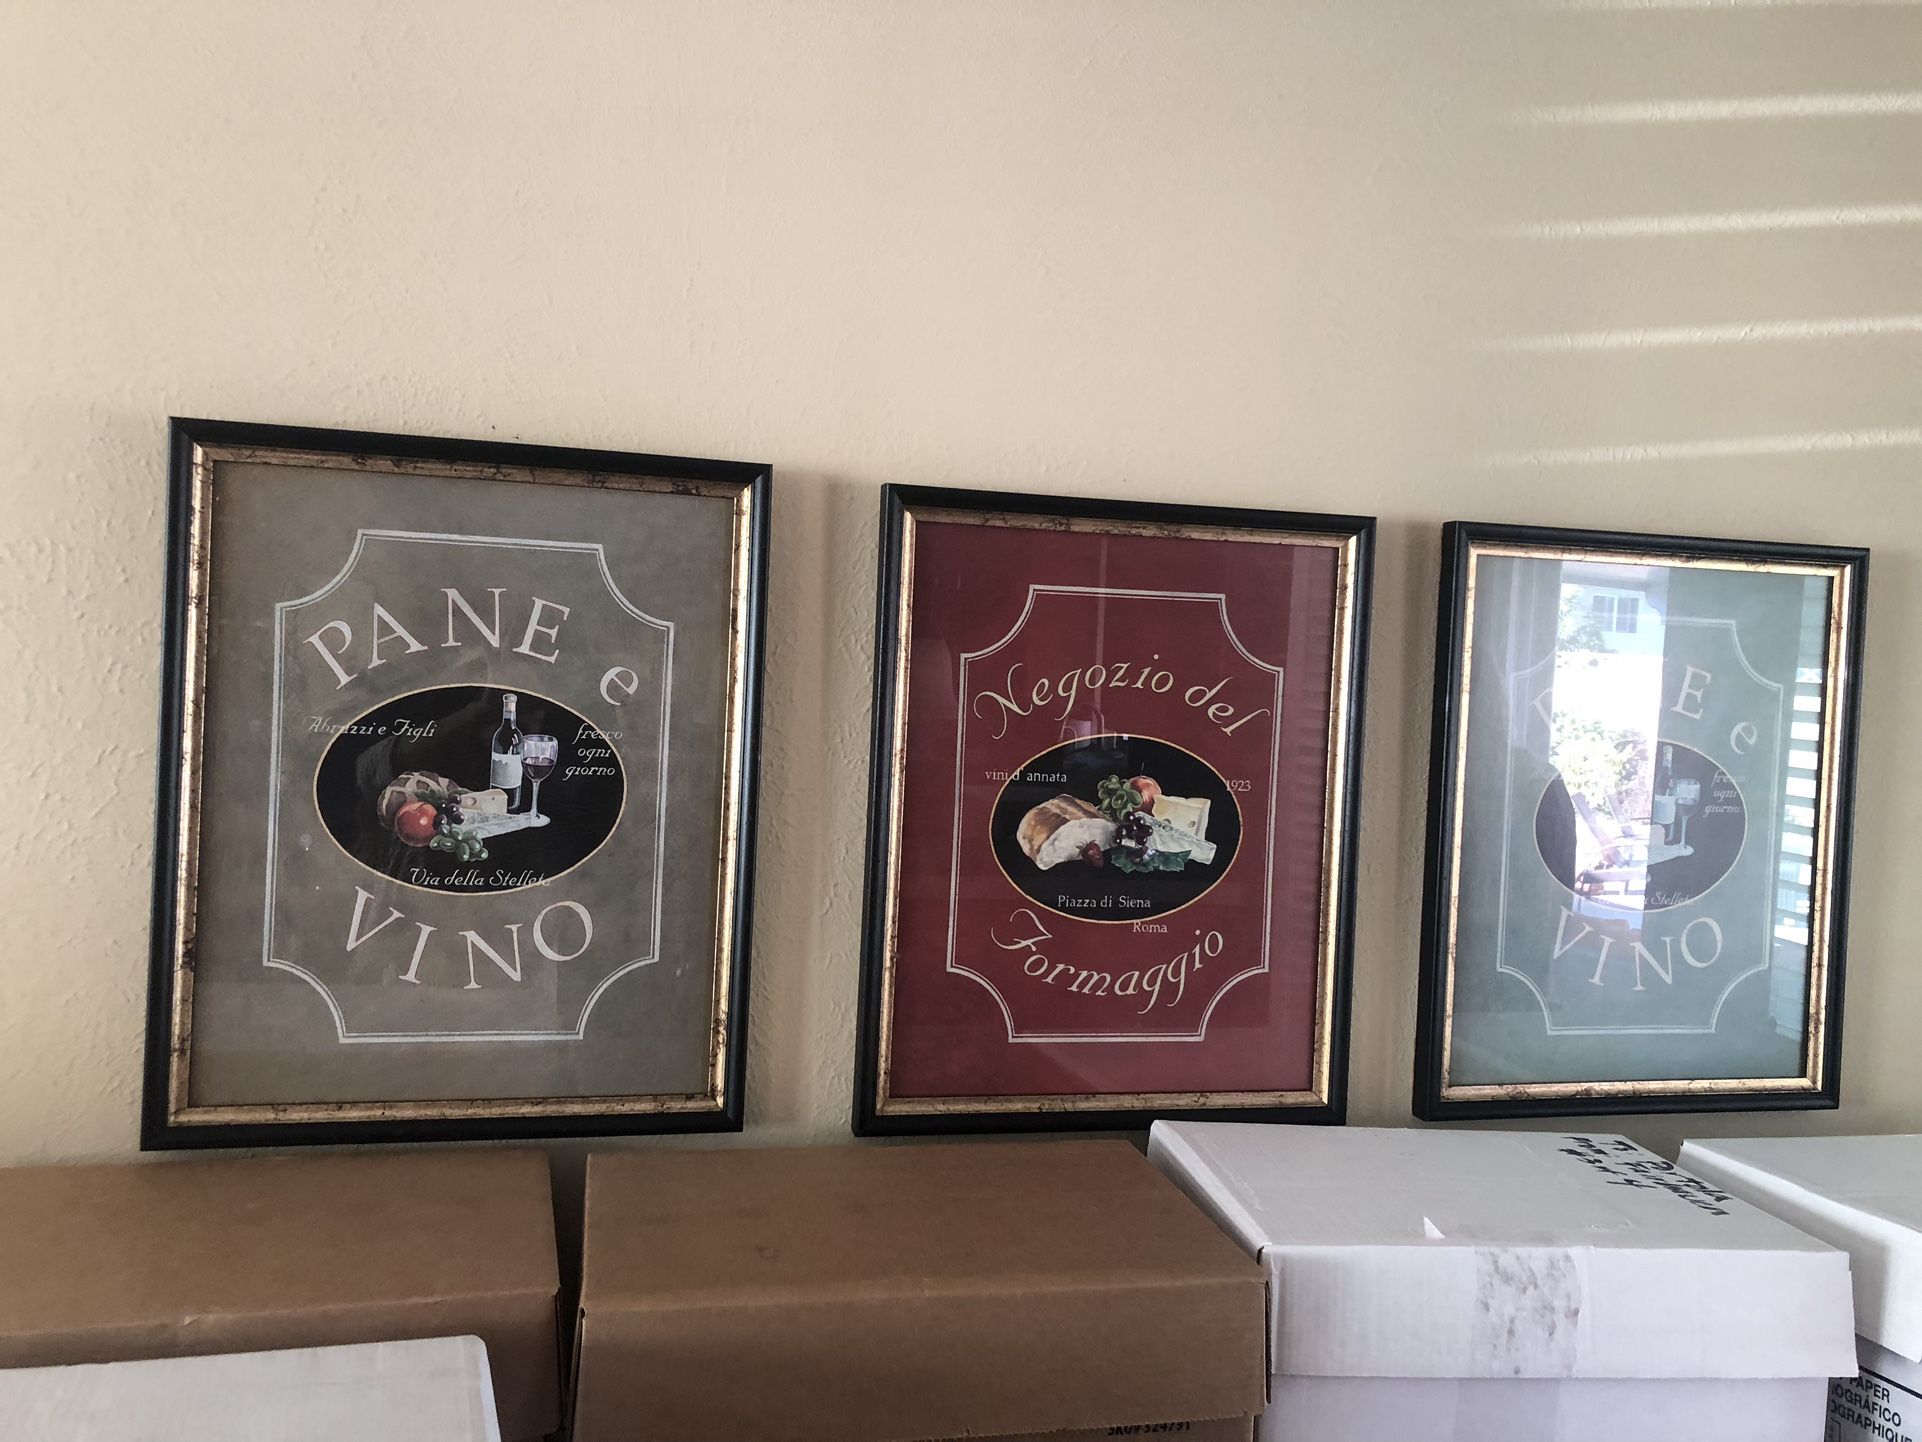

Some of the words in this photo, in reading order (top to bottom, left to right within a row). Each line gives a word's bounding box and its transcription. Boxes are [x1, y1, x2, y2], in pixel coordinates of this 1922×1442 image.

[302, 588, 571, 691] PANE
[599, 664, 640, 706] e
[973, 653, 1174, 740] Negozio
[1184, 676, 1271, 737] del
[377, 725, 388, 736] e
[391, 718, 438, 743] Figli
[571, 722, 624, 745] fresco
[1729, 720, 1758, 755] e
[577, 747, 612, 764] ogni
[562, 765, 616, 781] giorno
[985, 768, 1009, 781] vini
[1026, 772, 1067, 783] annata
[1225, 779, 1252, 792] 1923
[410, 867, 441, 886] Via
[444, 869, 486, 886] della
[1058, 895, 1097, 908] Piazza
[1100, 895, 1113, 908] di
[1118, 895, 1151, 908] Siena
[346, 885, 594, 990] VINO
[1132, 920, 1168, 934] Roma
[1552, 904, 1723, 992] VINO
[990, 908, 1224, 1015] Formaggio
[1830, 1383, 1902, 1427] OGRÁFICO
